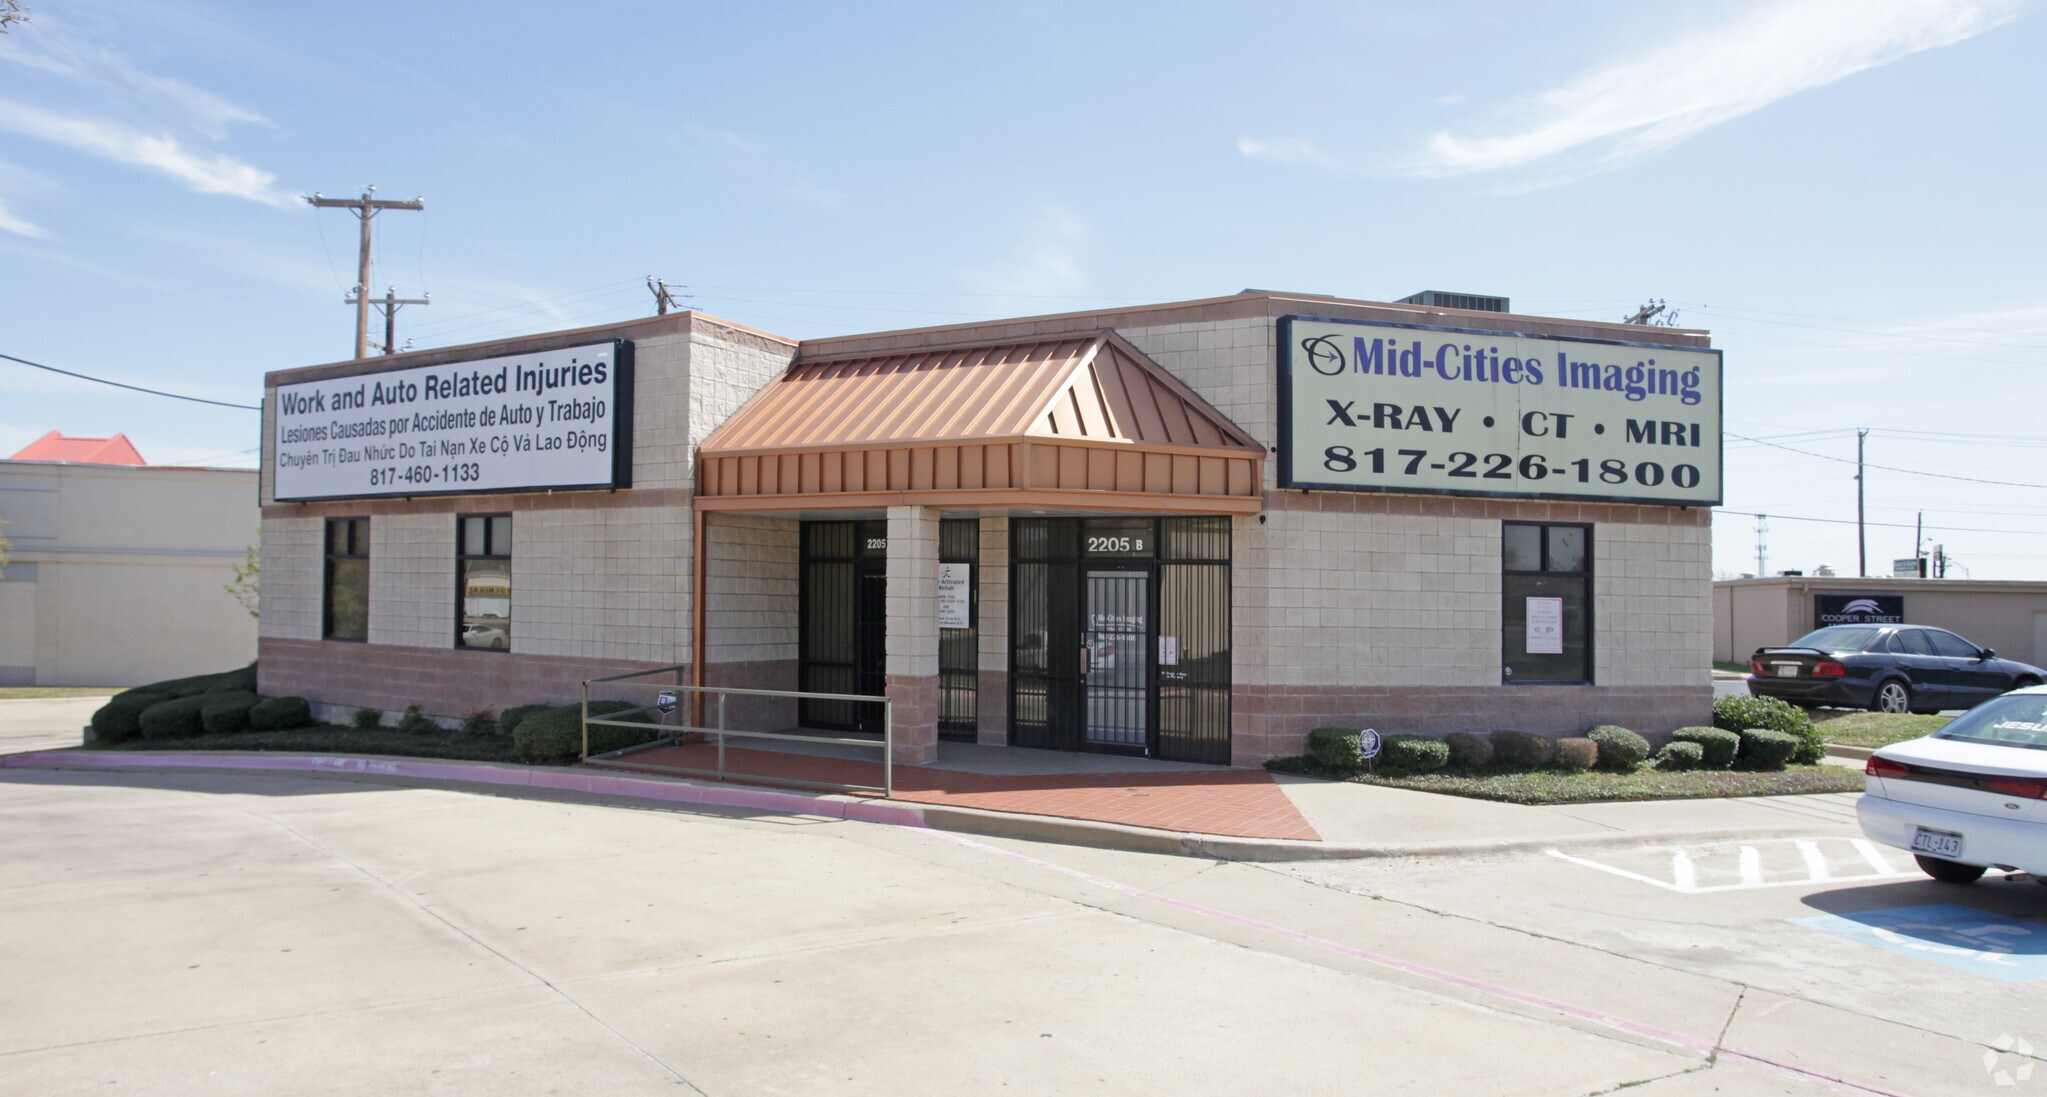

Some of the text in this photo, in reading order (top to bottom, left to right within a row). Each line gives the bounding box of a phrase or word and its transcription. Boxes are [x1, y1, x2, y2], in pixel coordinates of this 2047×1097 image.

[1354, 336, 1701, 406] Mid-Cities Imaging
[282, 358, 607, 416] Work and Auto Related Injuries
[281, 396, 605, 444] Lesiones Causadas por Accidente de Auto y Trabajo
[1326, 399, 1700, 447] X-RAY CT MRI
[399, 442, 415, 459] Do
[419, 440, 437, 457] Tai
[469, 437, 486, 455] Xe
[536, 433, 562, 451] Lao
[370, 462, 480, 486] 817-460-1133
[1323, 445, 1700, 488] 817-226-1800
[867, 538, 886, 549] 2205
[1088, 537, 1144, 552] 2205 B
[1821, 614, 1901, 623] COOPER STREET
[1993, 721, 2047, 732] JESU
